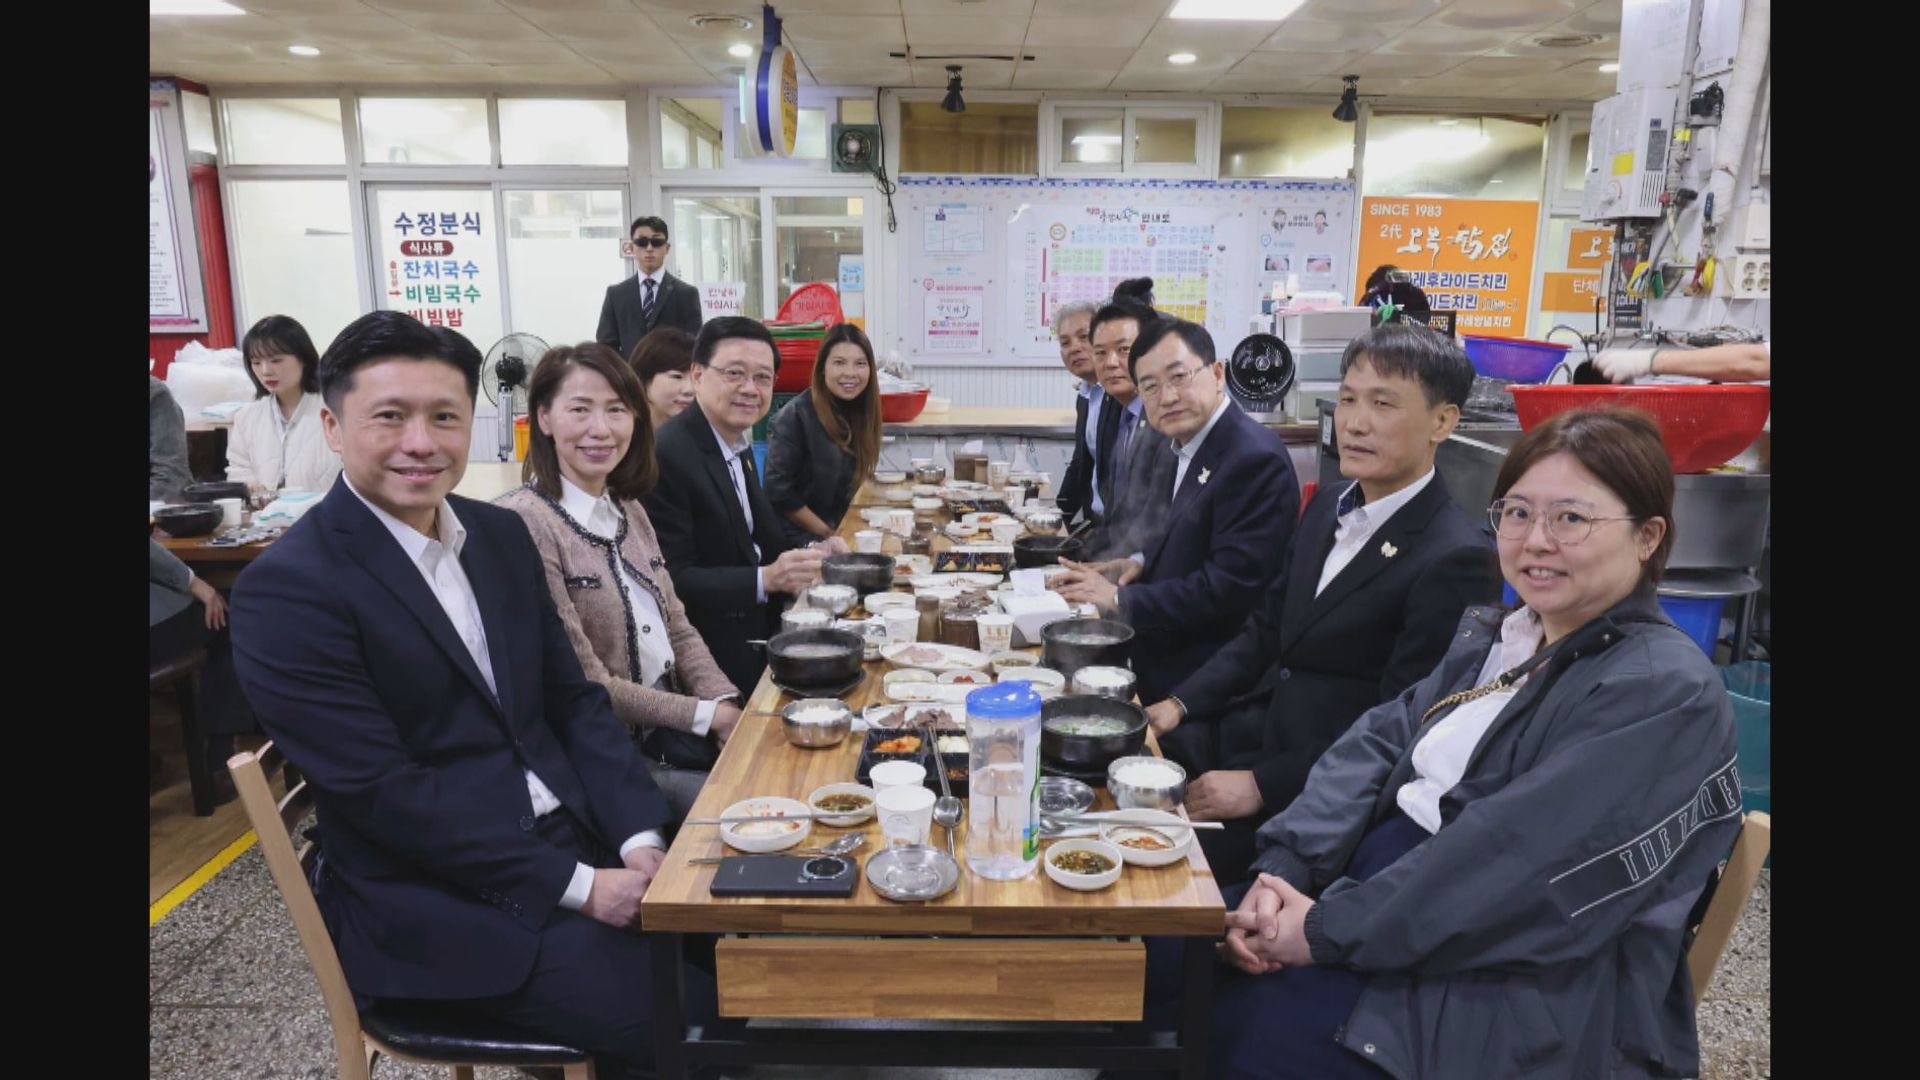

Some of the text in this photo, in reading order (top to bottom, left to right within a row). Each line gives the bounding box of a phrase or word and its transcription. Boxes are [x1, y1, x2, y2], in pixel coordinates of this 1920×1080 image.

[1370, 204, 1442, 217] SINCE 1983
[394, 212, 481, 236] 수정분식
[409, 241, 445, 254] 식사류
[403, 260, 479, 279] 잔치국수
[405, 284, 481, 303] 비빔국수
[1426, 293, 1478, 309] 이드치킨
[408, 308, 463, 327] 비빔밥
[1619, 827, 1671, 883] THE
